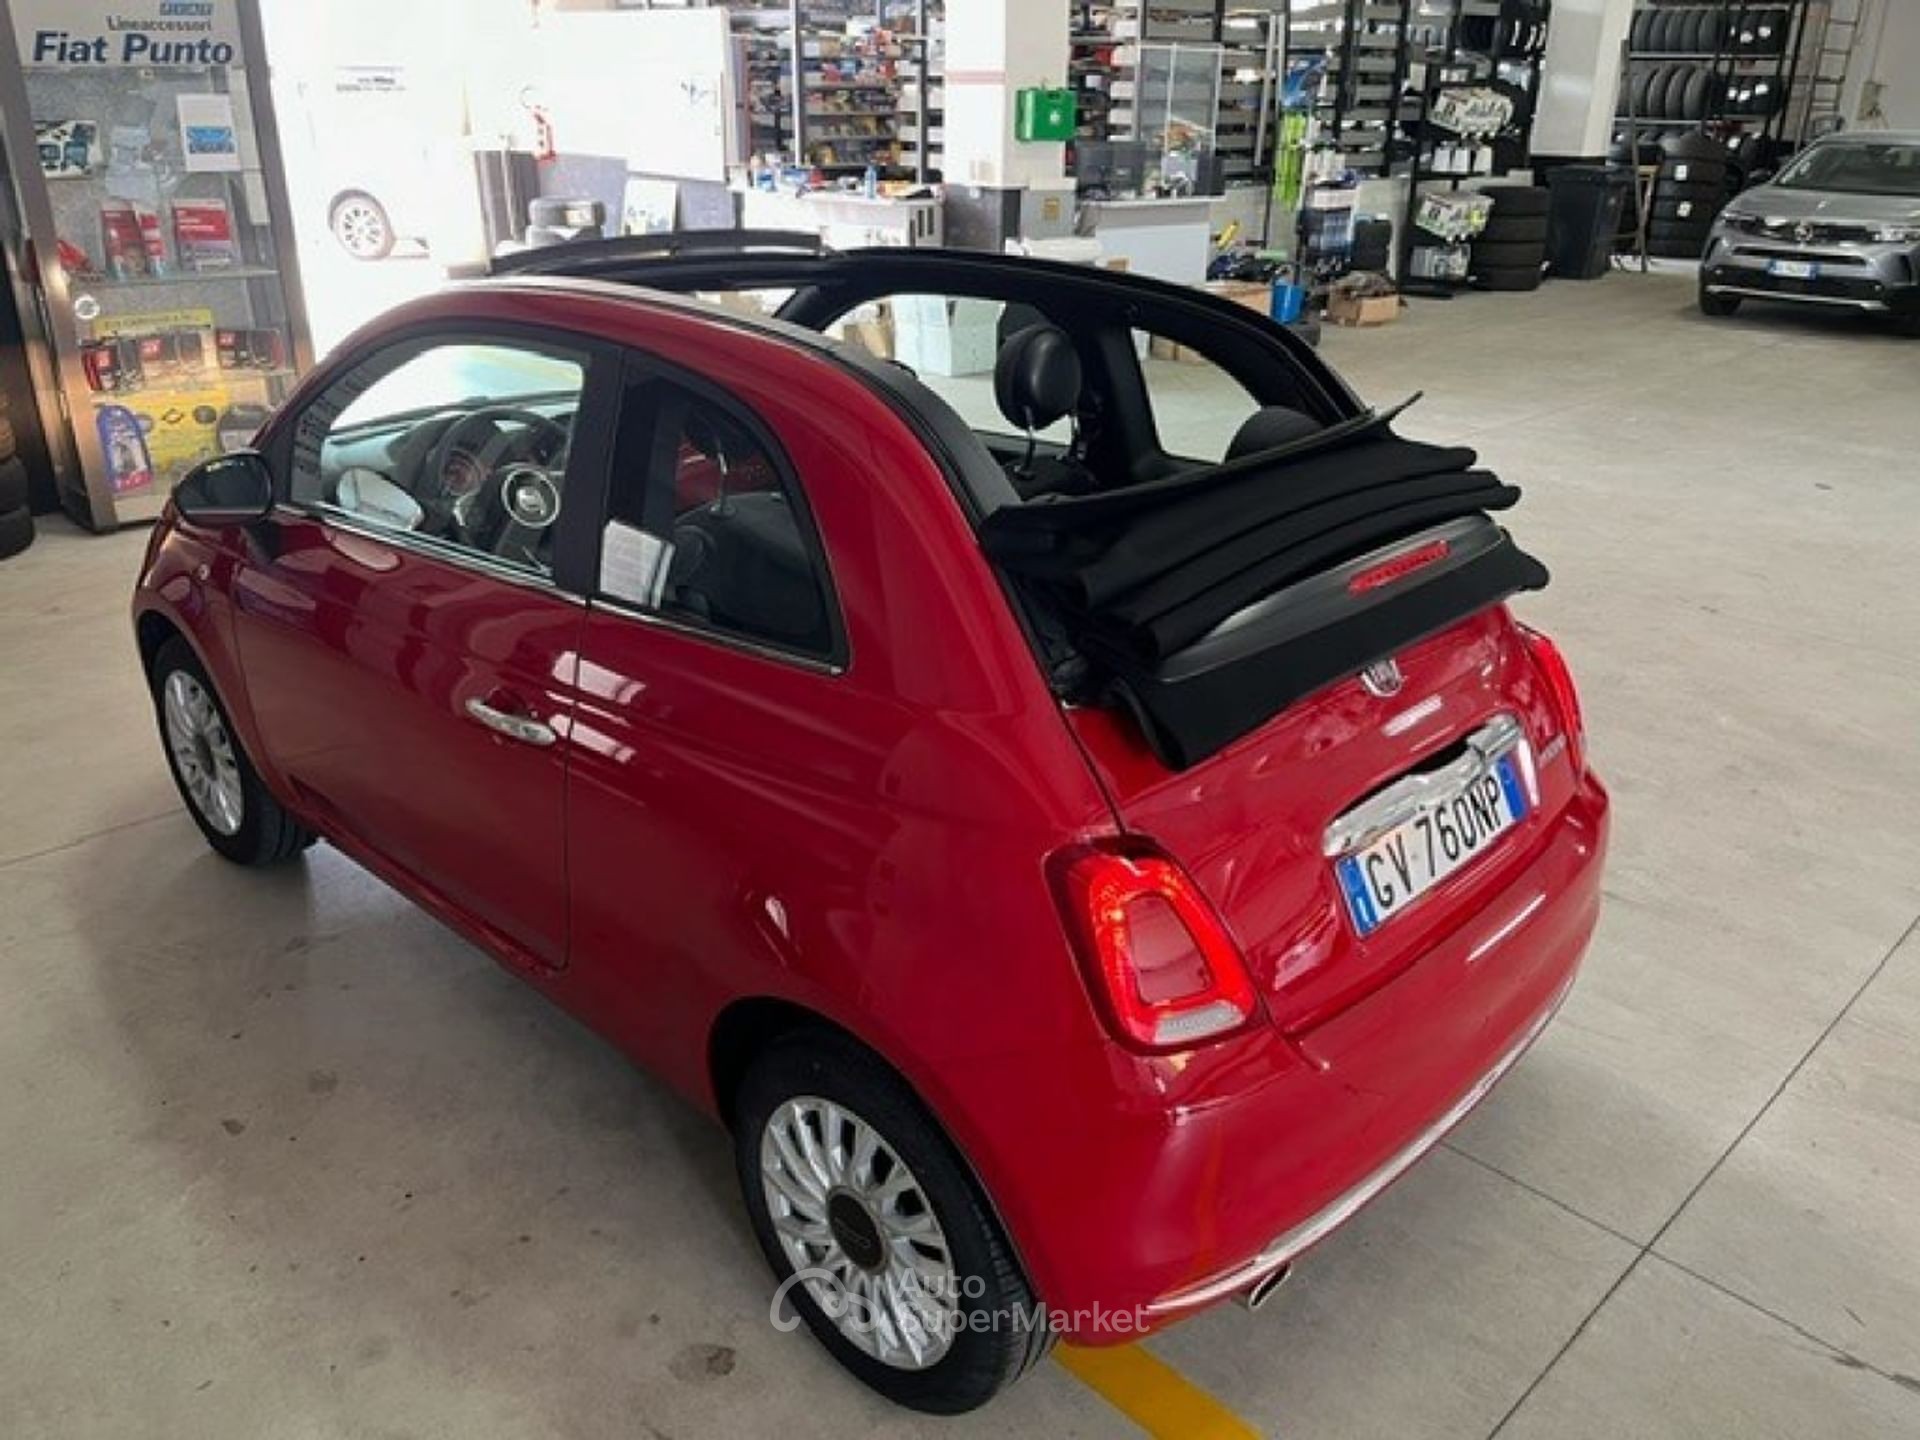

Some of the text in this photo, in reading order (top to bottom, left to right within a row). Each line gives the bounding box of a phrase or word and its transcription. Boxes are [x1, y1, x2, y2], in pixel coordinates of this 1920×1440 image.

[106, 16, 212, 31] Lineaccessori
[34, 31, 233, 64] Fiat Punto
[1365, 776, 1501, 909] GV 760NP
